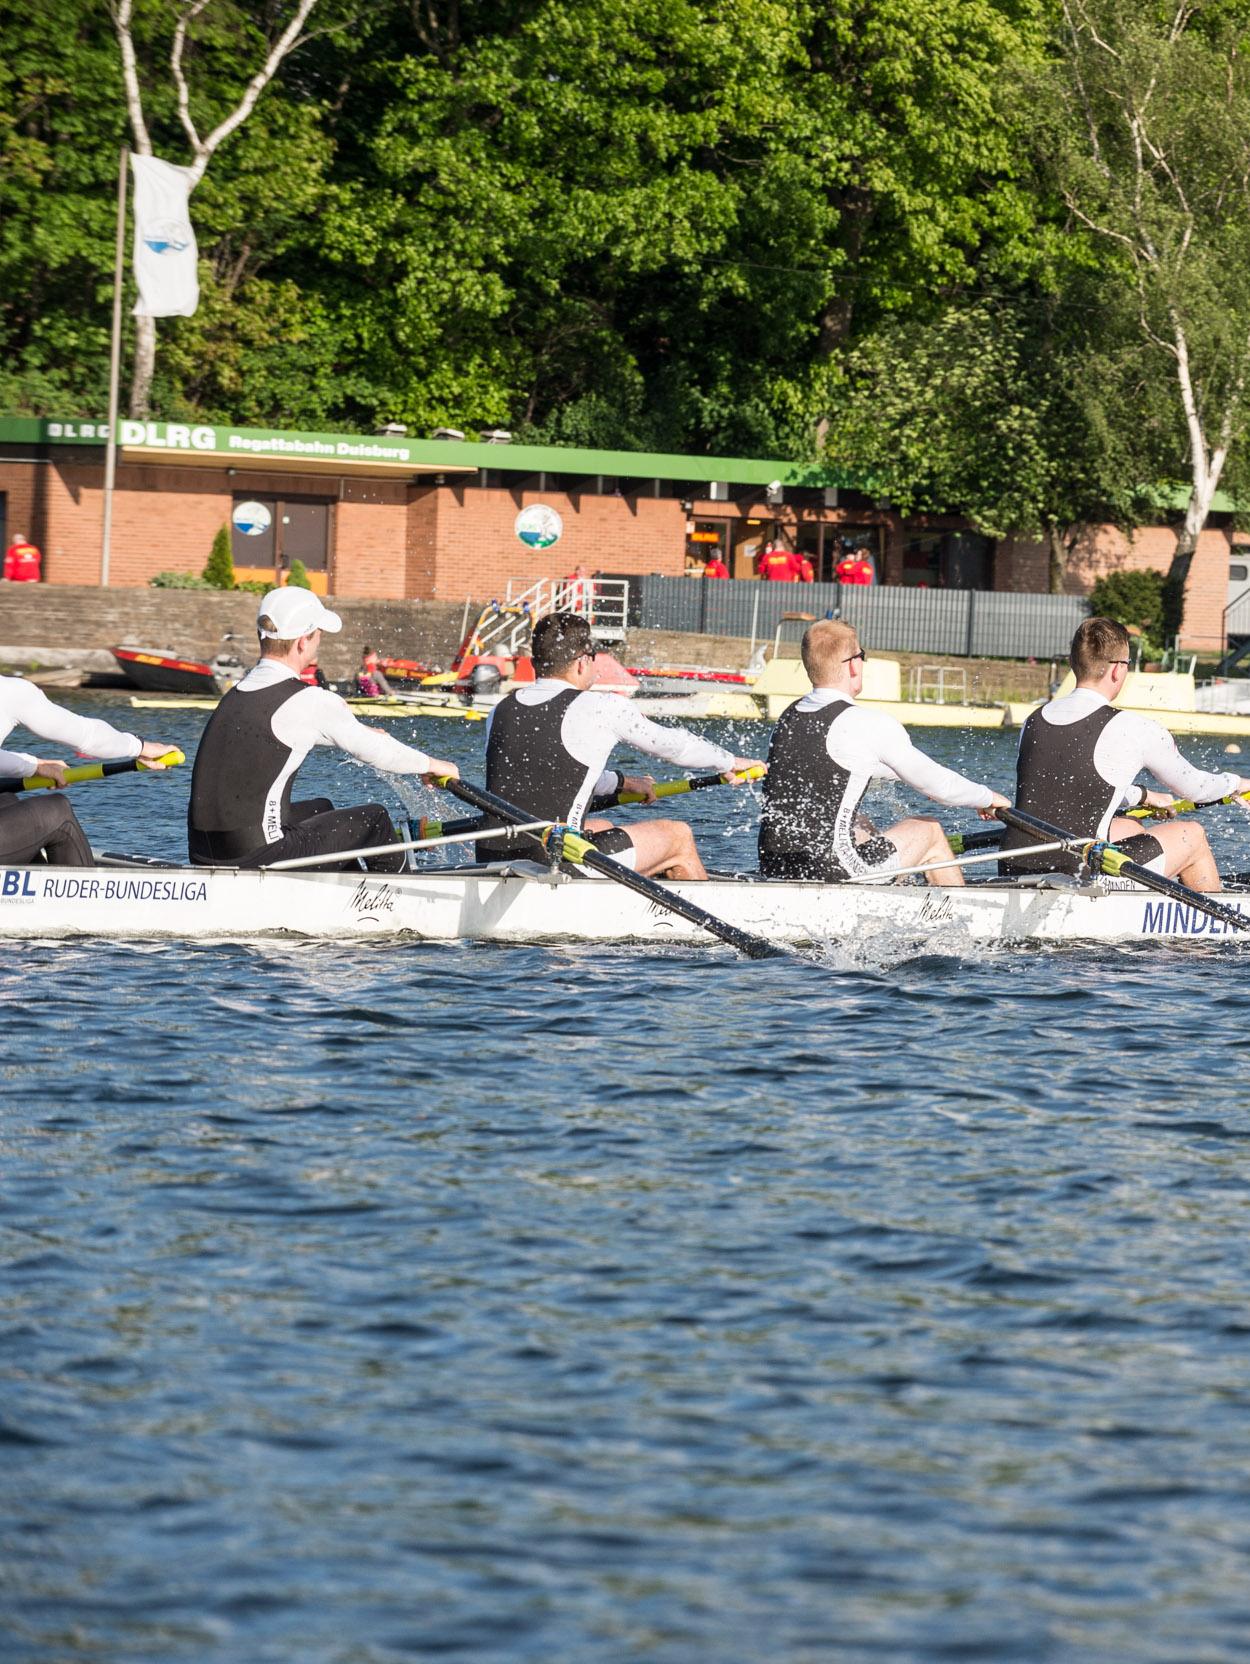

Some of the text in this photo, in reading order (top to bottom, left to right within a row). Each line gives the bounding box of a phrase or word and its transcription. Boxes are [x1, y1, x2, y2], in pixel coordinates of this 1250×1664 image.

[120, 422, 410, 461] DLRG Regattabahn Duisburg
[0, 870, 207, 901] BL RUDER-BUNDESLIGA
[343, 877, 395, 912] Melitta
[914, 891, 953, 923] Melitta
